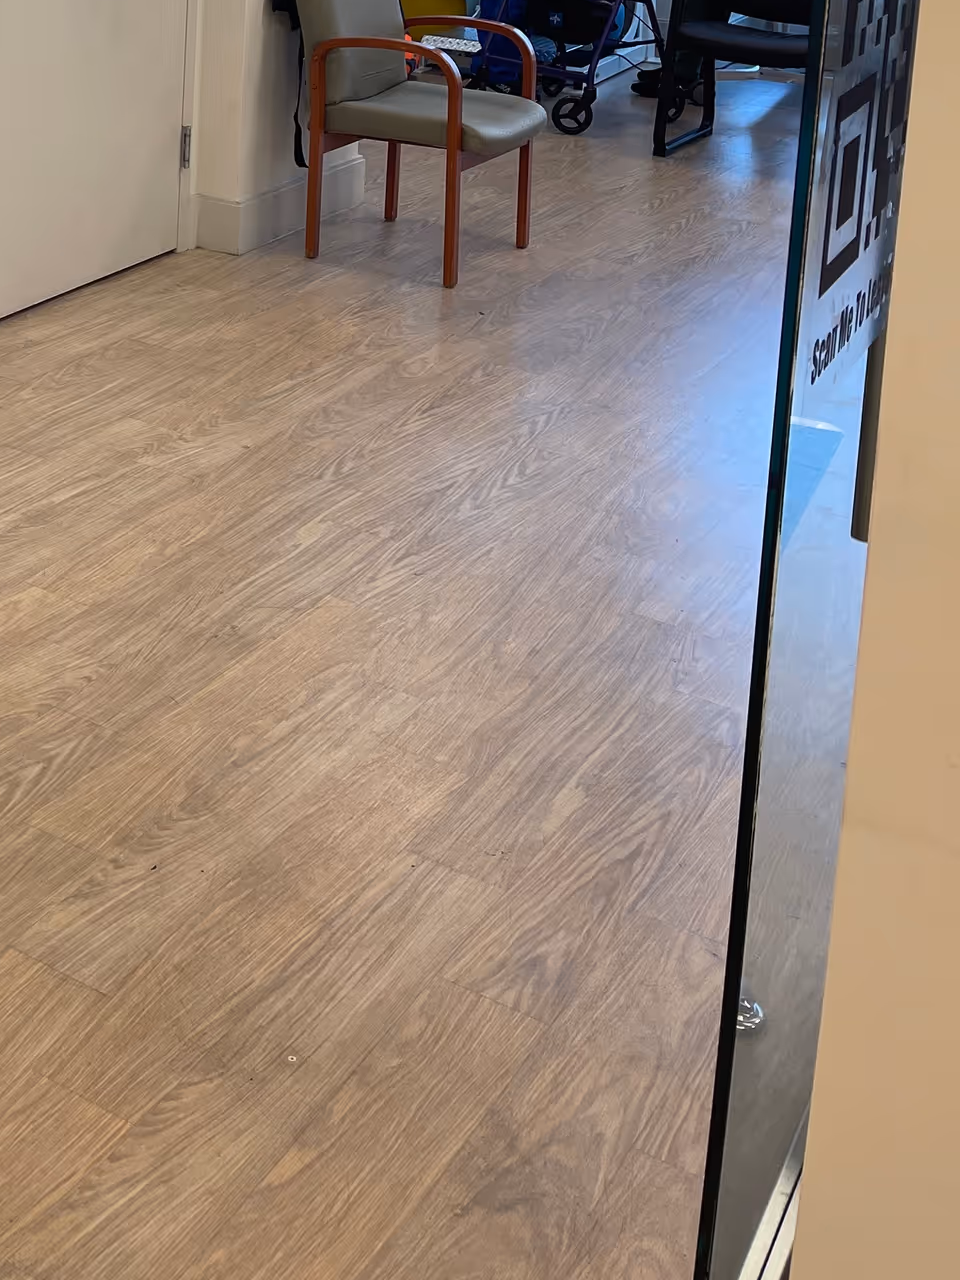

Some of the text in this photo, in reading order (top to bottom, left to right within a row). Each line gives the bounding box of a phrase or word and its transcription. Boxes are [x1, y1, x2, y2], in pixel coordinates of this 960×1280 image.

[810, 324, 839, 386] Scan
[838, 304, 854, 353] Me
[854, 289, 866, 333] To
